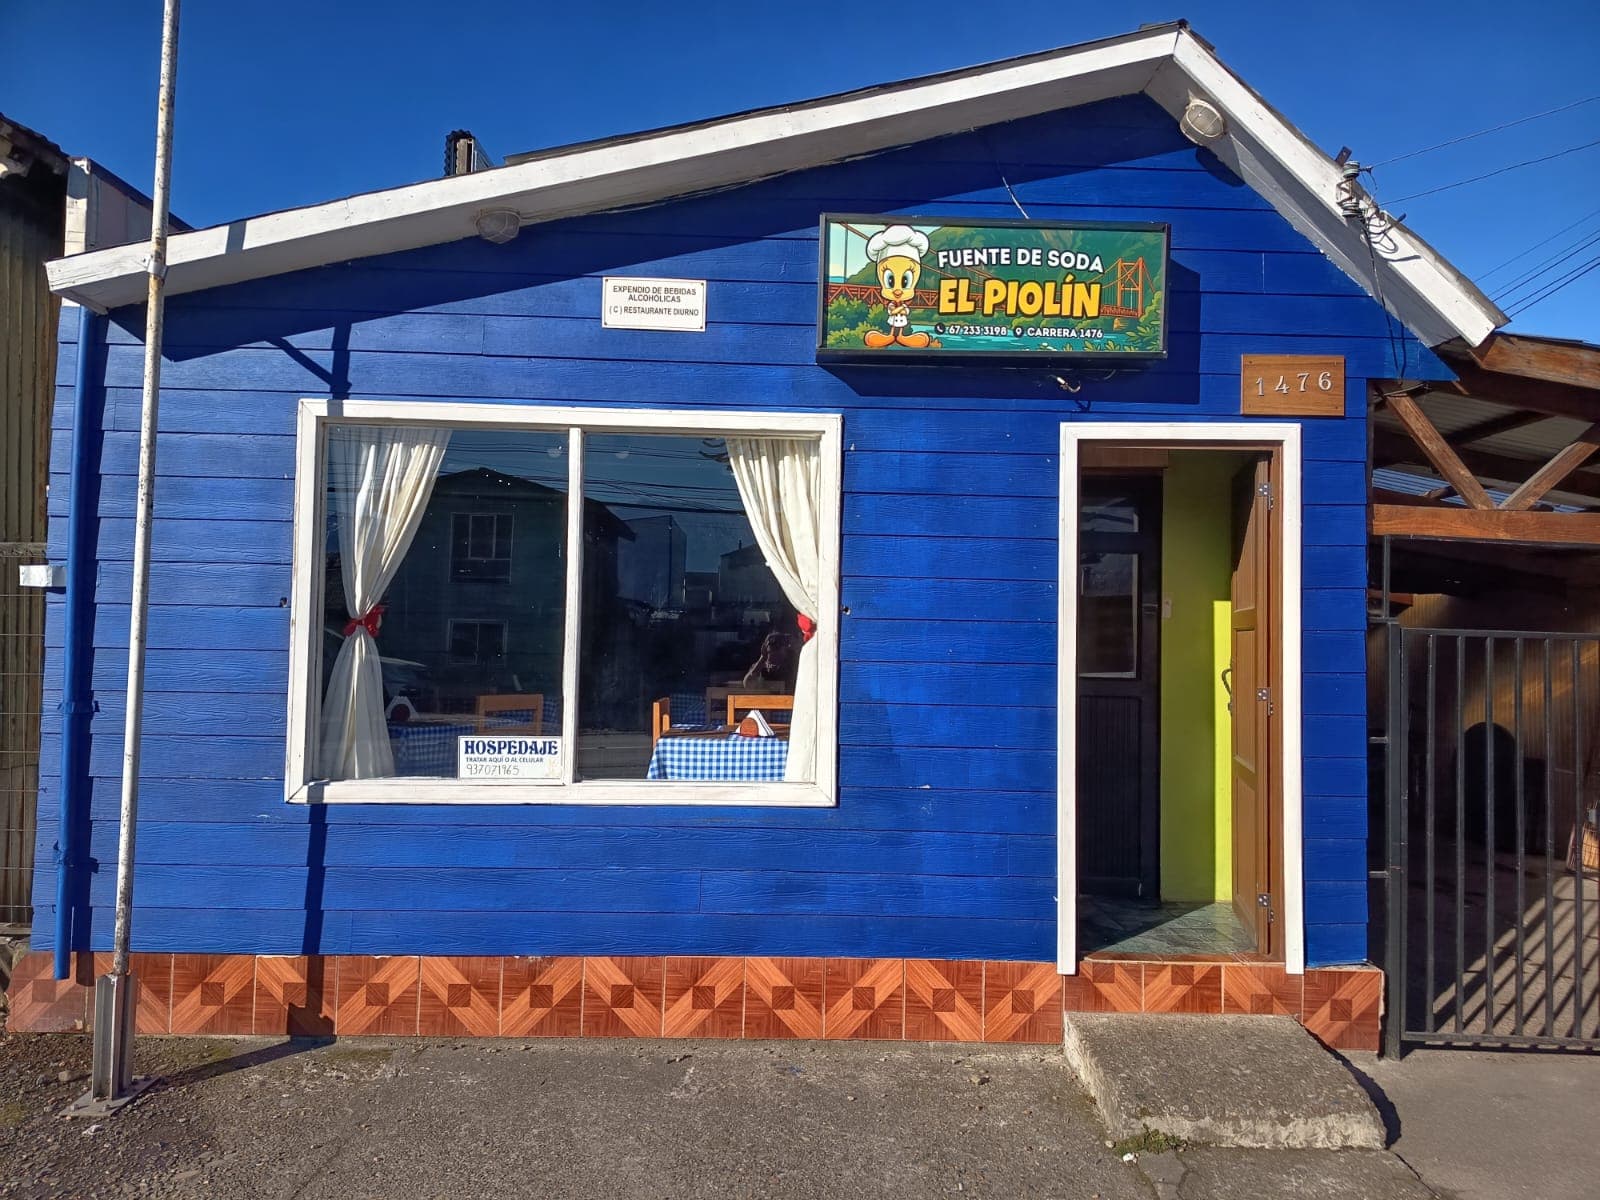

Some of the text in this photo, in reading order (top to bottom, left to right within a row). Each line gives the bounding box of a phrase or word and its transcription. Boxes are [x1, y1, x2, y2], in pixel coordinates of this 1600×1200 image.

[938, 248, 1104, 273] FUENTE DE SODA
[613, 285, 650, 294] EXPENDIO
[664, 287, 697, 295] BEBIDAS
[939, 274, 1101, 318] EL PIOLÍN
[624, 306, 671, 315] RESTAURANTE
[673, 308, 699, 316] DIURNO
[949, 325, 1007, 336] 67 233 3198
[1027, 327, 1103, 339] CARRERA 1476
[464, 740, 558, 755] HOSPEDAJE
